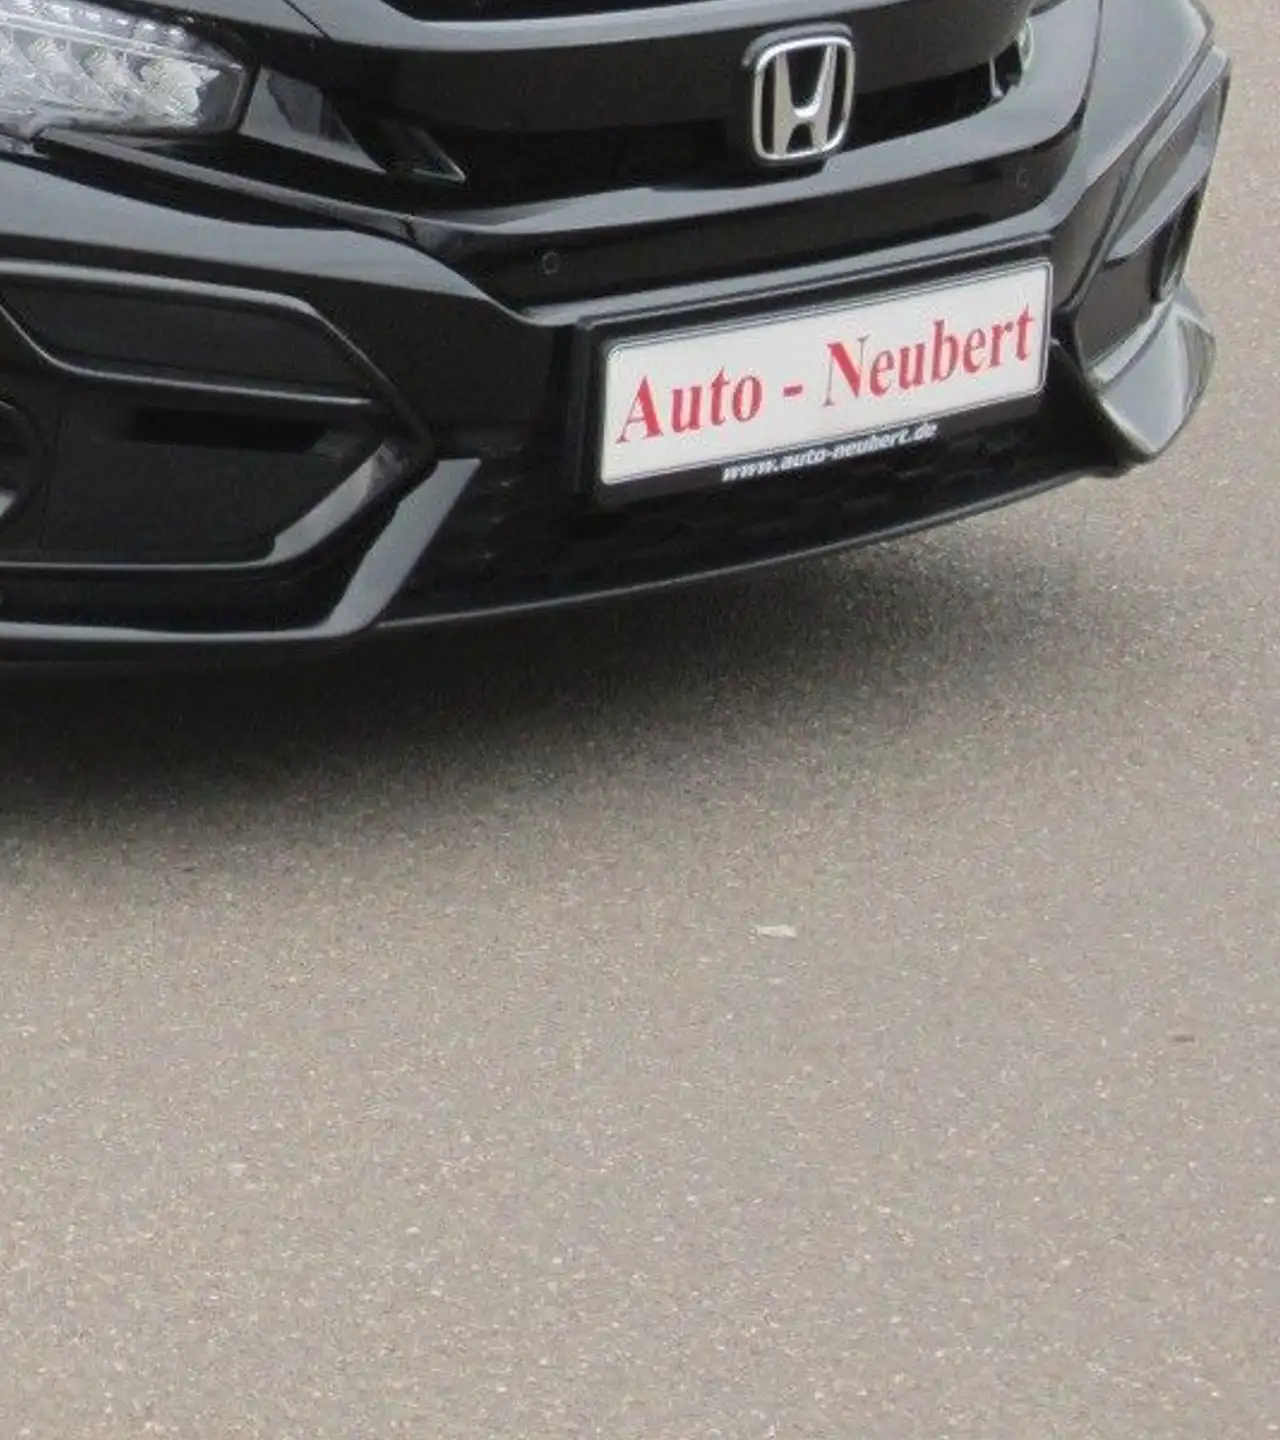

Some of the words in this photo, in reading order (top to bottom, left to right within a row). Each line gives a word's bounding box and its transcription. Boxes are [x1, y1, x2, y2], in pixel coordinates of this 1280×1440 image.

[617, 368, 763, 443] Auto
[824, 304, 1034, 406] Neubert
[722, 423, 937, 481] www.auto-neubert.de
